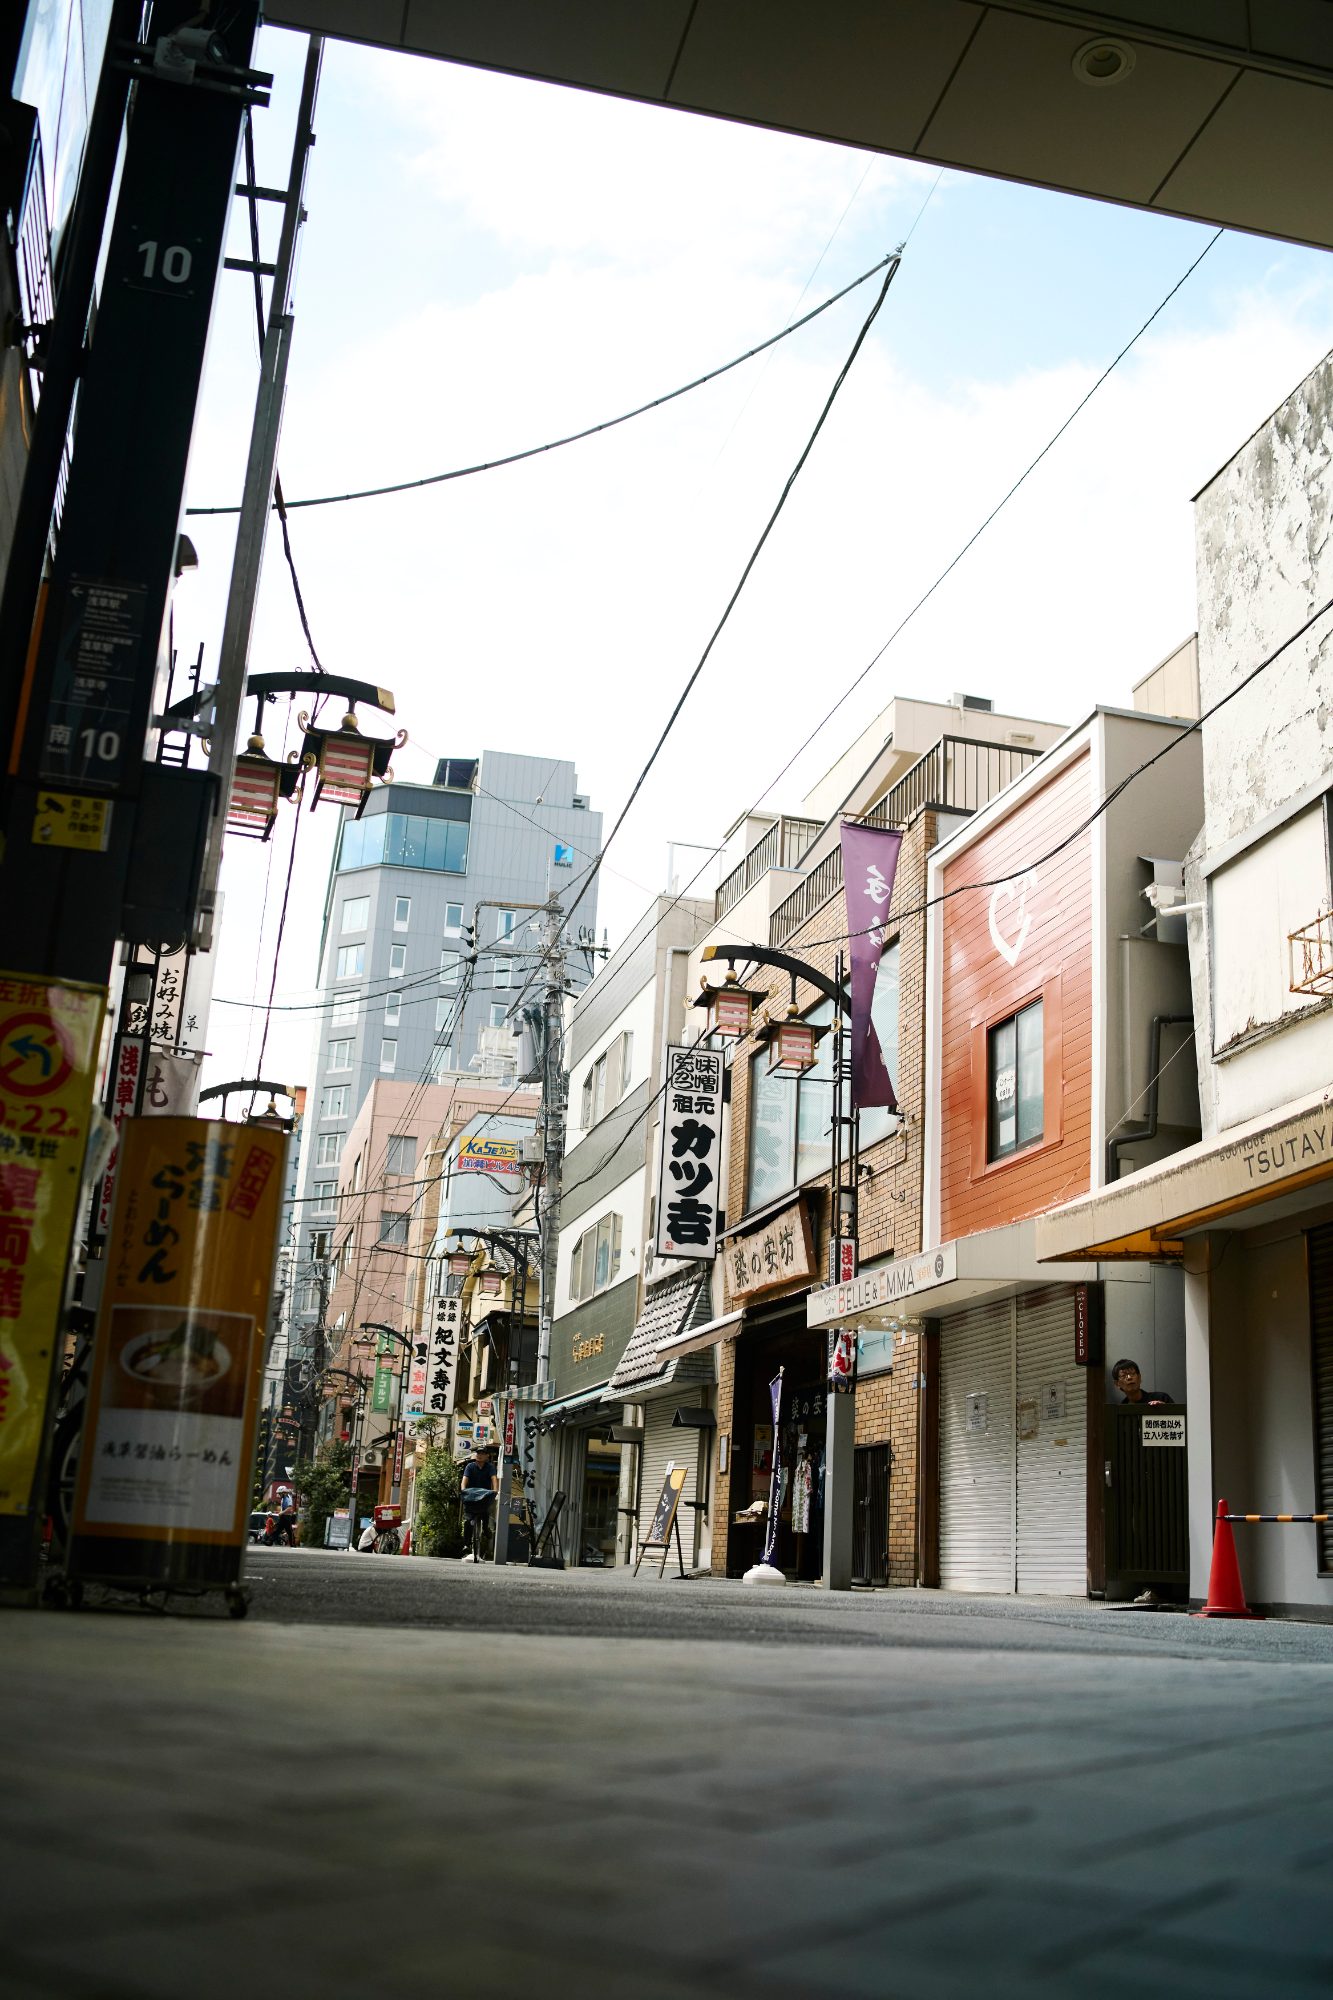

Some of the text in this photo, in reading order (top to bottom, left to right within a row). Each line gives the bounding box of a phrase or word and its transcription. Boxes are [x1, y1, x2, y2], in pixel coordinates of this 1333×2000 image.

[137, 240, 193, 284] 10
[49, 724, 121, 762] 南 10
[554, 861, 573, 869] HULIC
[151, 968, 184, 1041] お好み焼
[1243, 1122, 1333, 1178] TSUTAY
[666, 1117, 716, 1246] カツ吉
[138, 1164, 184, 1284] らーめん
[733, 1225, 796, 1291] 染の安坊
[838, 1280, 870, 1314] BELLE
[879, 1264, 915, 1302] EMMA
[791, 1392, 827, 1421] 染の安
[1145, 1419, 1182, 1429] 関係者以外
[1143, 1431, 1184, 1441] 立入りを禁ず
